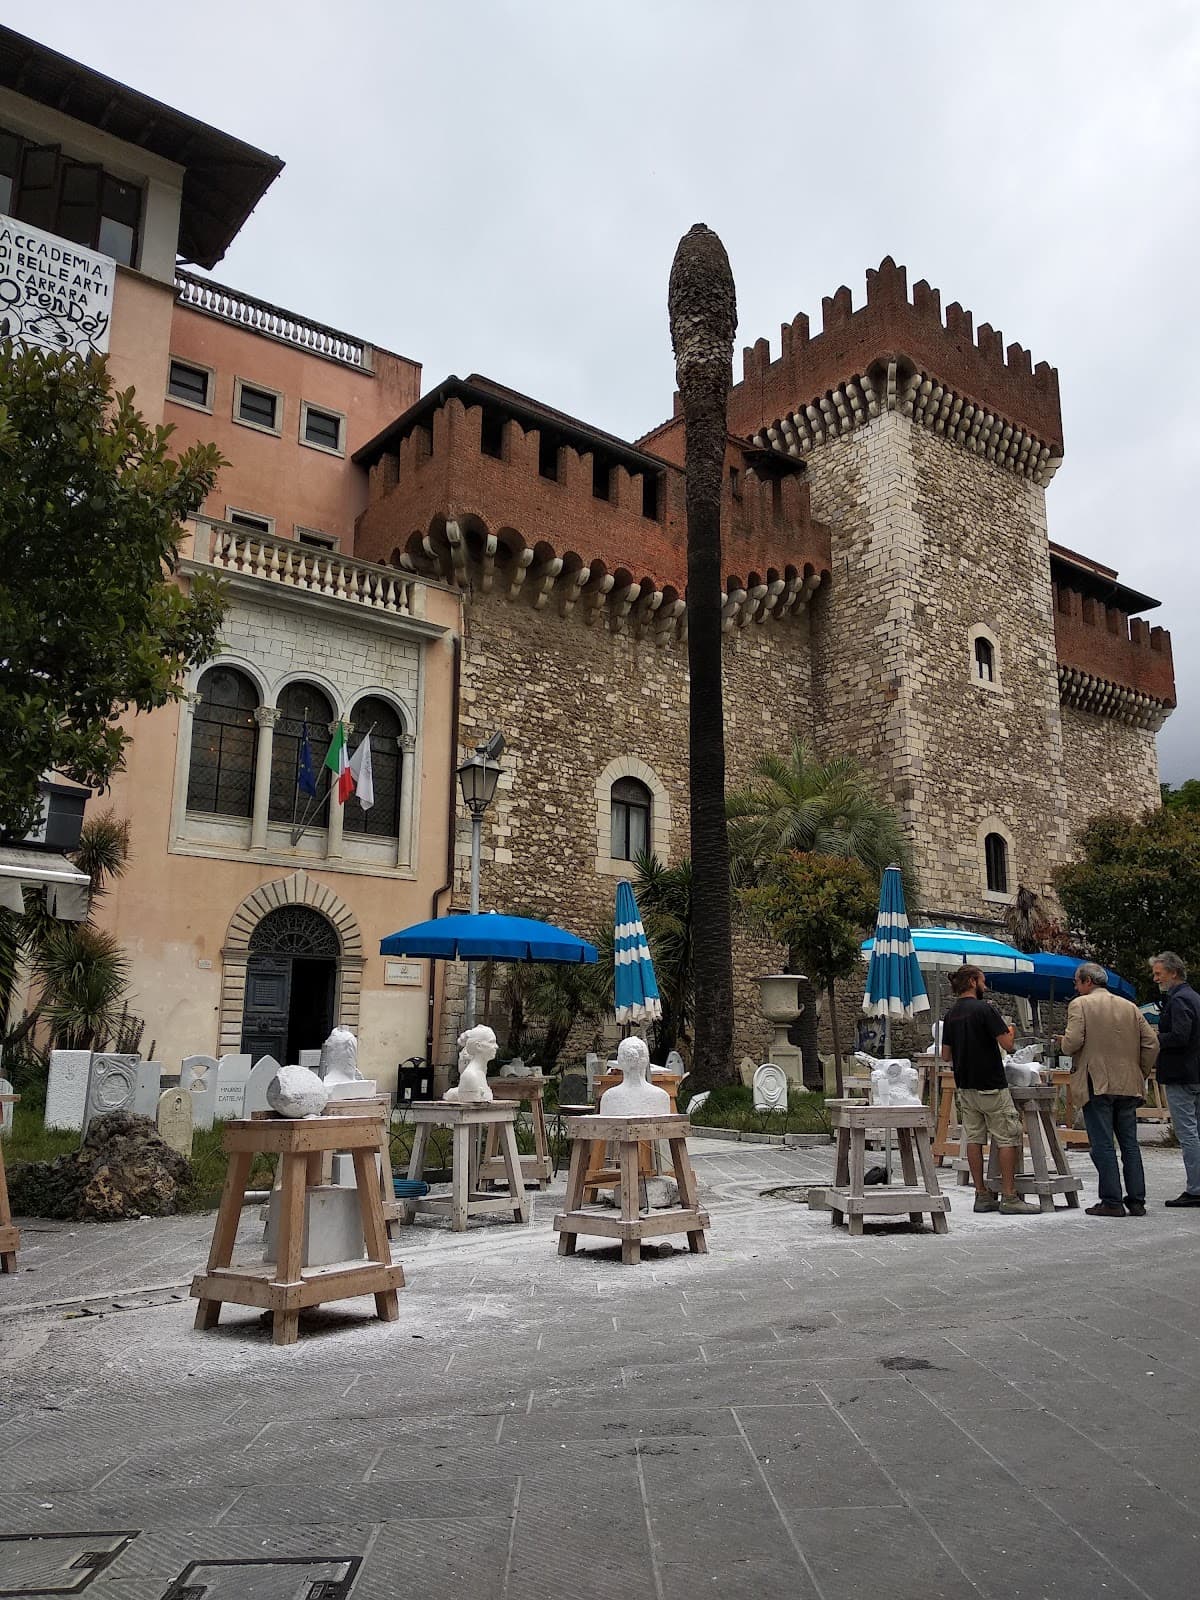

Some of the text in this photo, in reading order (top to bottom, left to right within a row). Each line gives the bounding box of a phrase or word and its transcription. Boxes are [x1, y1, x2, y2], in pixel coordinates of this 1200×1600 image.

[0, 229, 103, 279] ACCADEMIA
[17, 252, 69, 282] BELLE
[72, 274, 108, 297] ARTI
[16, 269, 88, 306] CARRARA
[67, 301, 109, 341] Day
